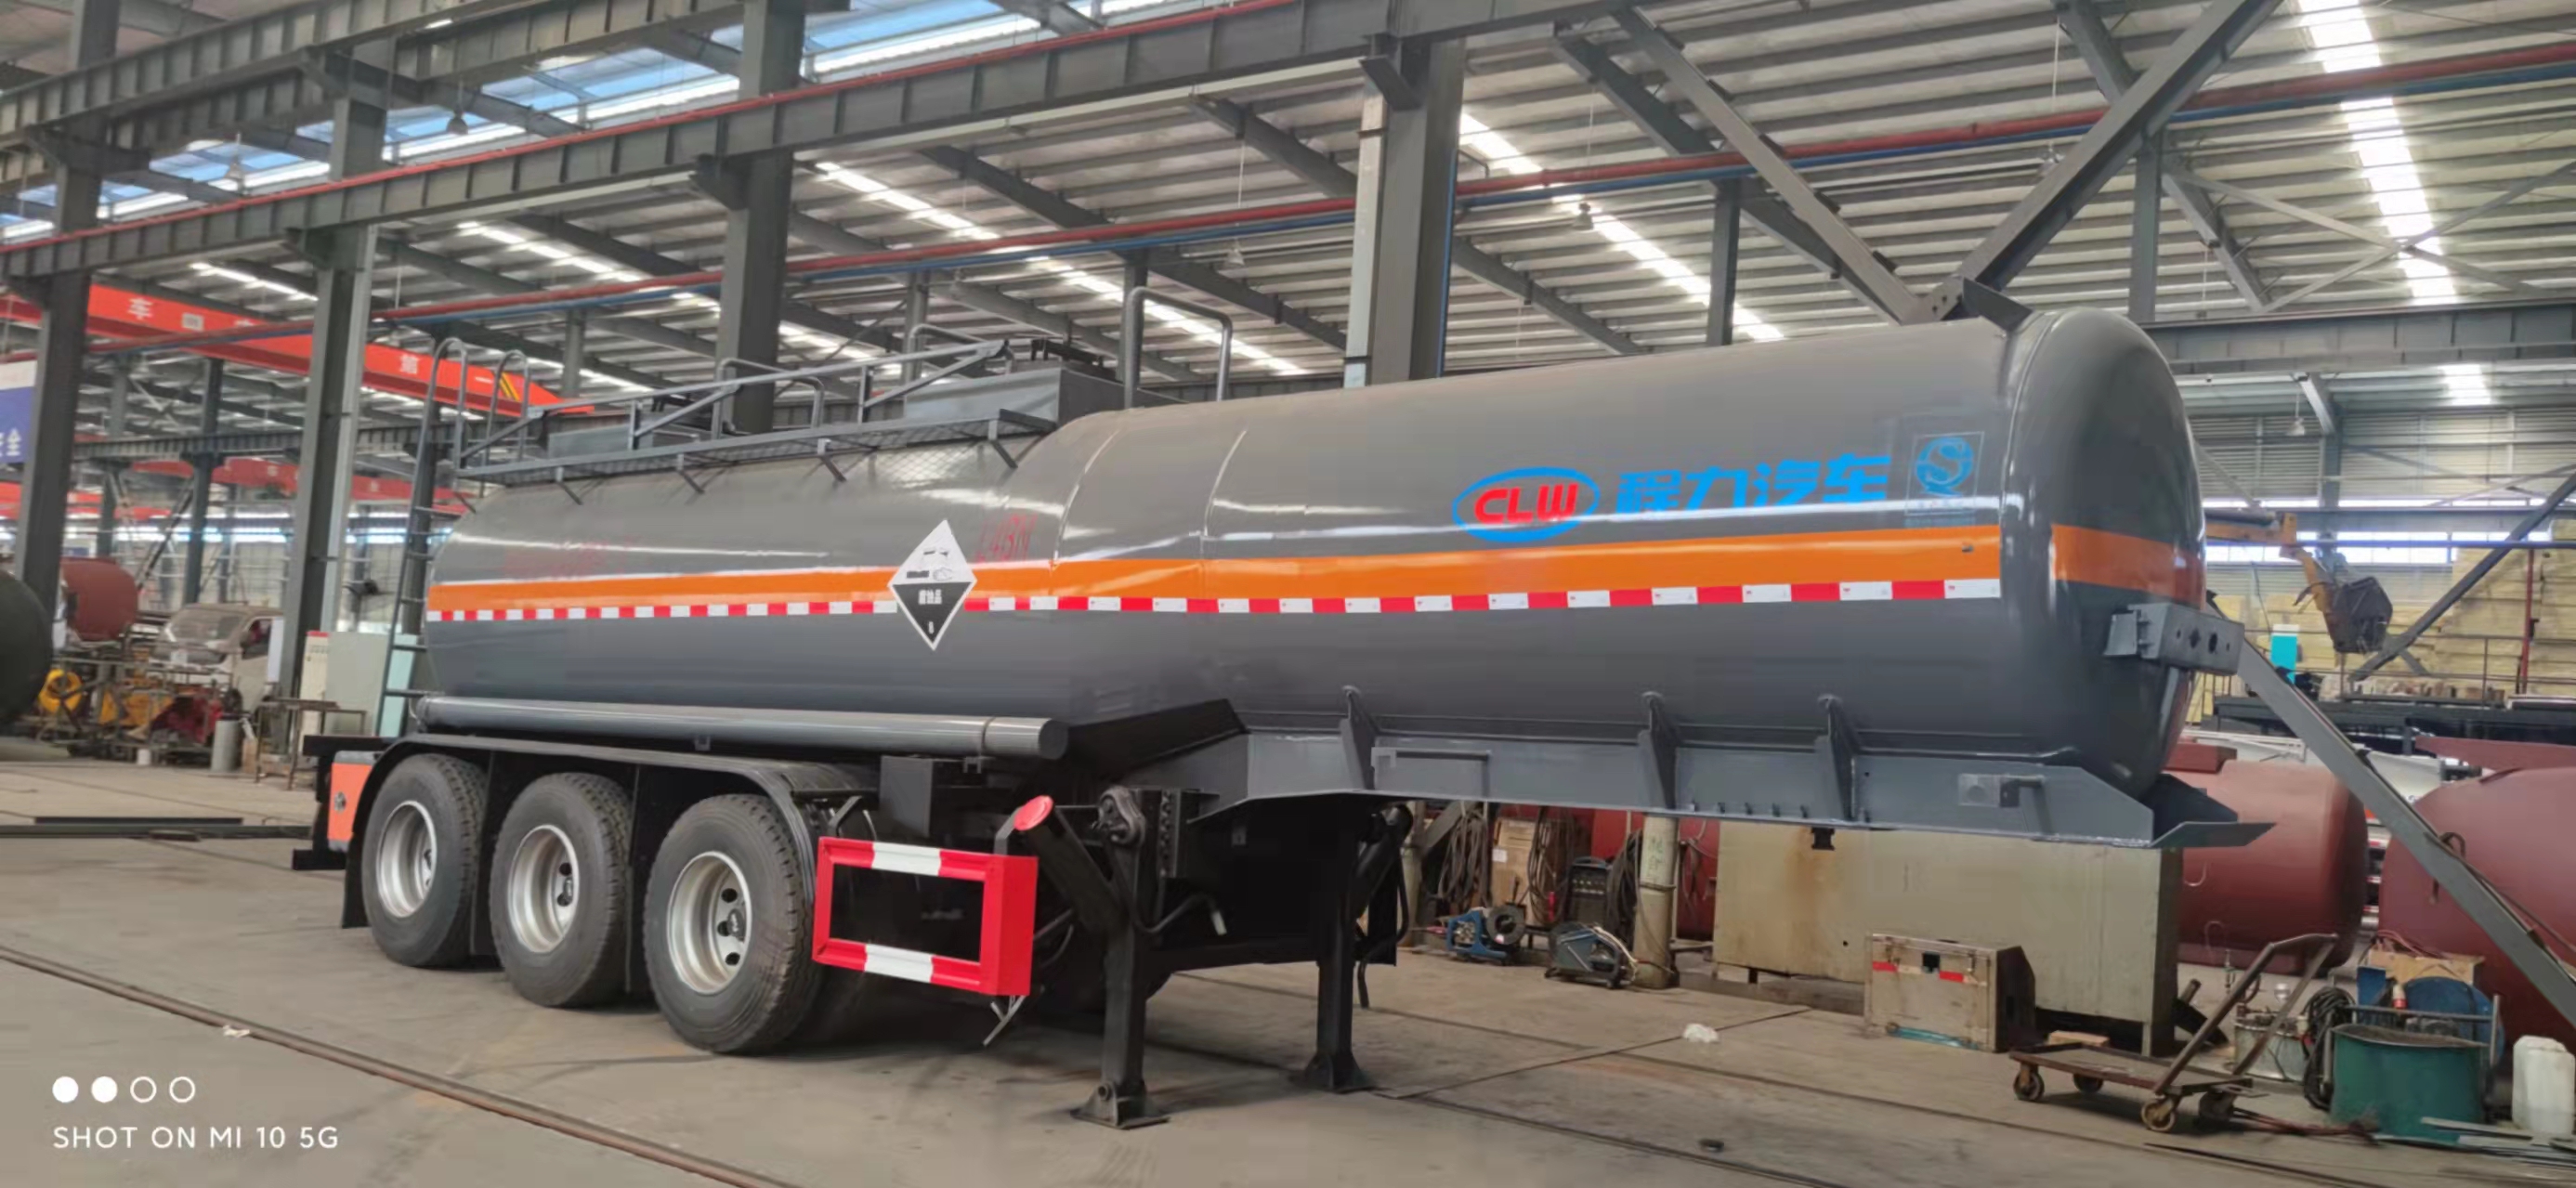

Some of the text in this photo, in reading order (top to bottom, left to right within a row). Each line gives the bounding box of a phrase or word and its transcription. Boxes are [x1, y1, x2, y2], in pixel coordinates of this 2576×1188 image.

[1474, 482, 1578, 525] CLW
[1615, 453, 1891, 514] 程力汽车
